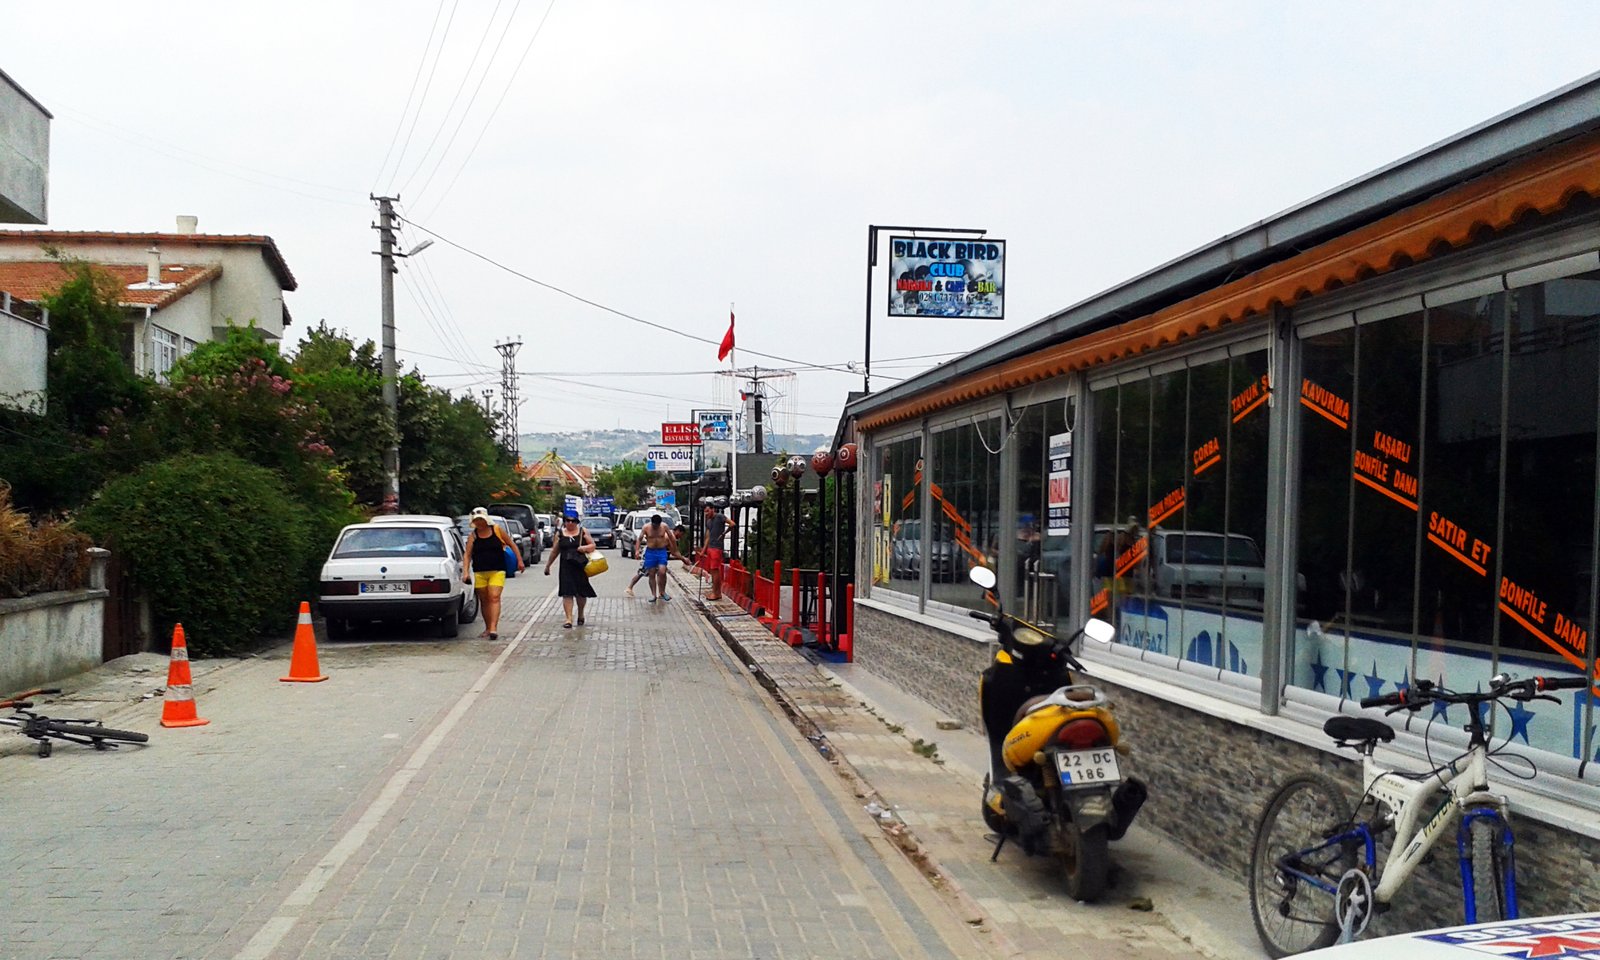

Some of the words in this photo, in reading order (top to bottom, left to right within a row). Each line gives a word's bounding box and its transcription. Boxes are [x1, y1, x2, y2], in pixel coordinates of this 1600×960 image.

[894, 241, 952, 259] BLACK
[955, 243, 999, 261] BIRD
[930, 263, 965, 277] CLUB
[1301, 378, 1350, 421] KAVURMA
[648, 451, 668, 460] OTEL
[671, 448, 693, 460] OĞUZ
[1373, 430, 1411, 464] KAŞARLI
[1354, 449, 1389, 483] BONFİLE
[1393, 469, 1418, 498] DANA
[1429, 511, 1467, 551] SATIR
[1471, 538, 1492, 565] ET
[1500, 576, 1548, 624] BONFİLE
[1554, 612, 1588, 654] DANA
[1063, 754, 1082, 767] 22
[1092, 752, 1112, 764] DC
[1077, 768, 1105, 780] 186
